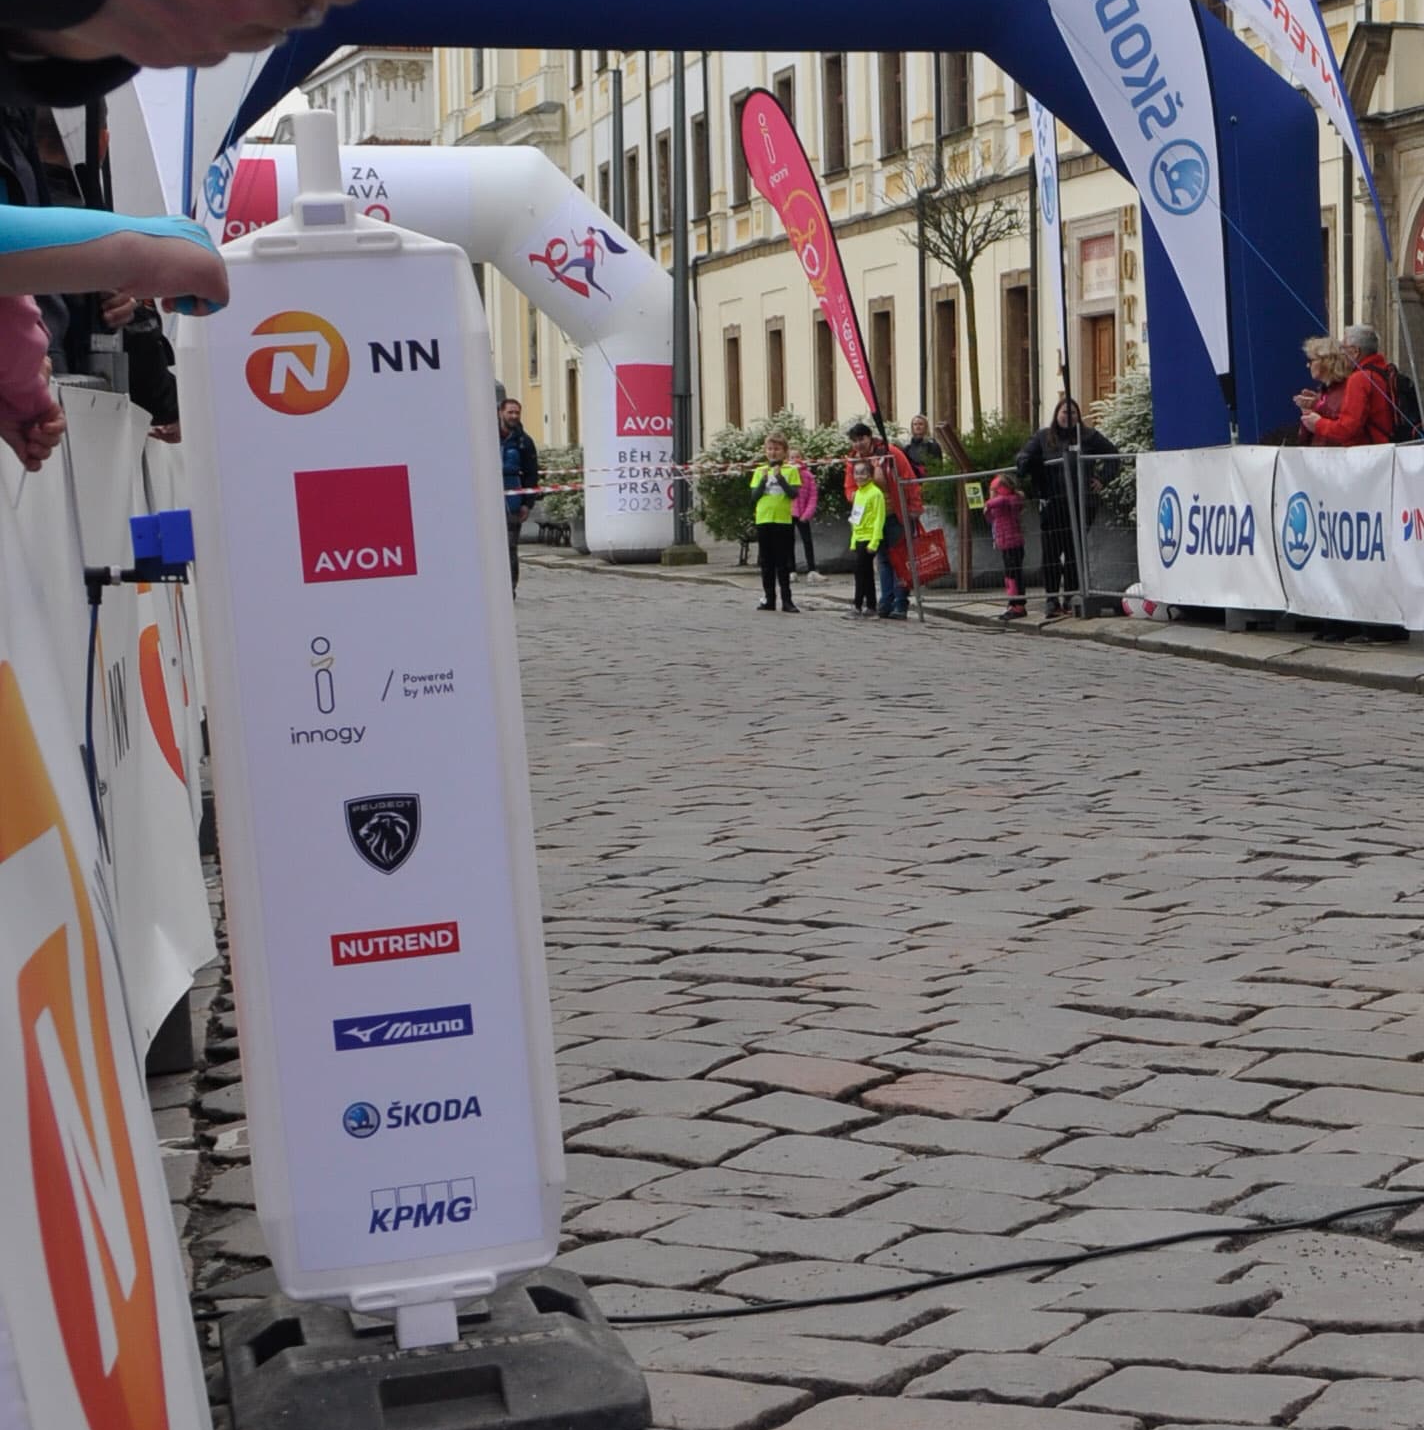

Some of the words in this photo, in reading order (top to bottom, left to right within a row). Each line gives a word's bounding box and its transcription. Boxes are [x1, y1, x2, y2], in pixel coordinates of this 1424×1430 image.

[352, 167, 379, 179] ZA
[368, 339, 441, 373] NN
[618, 497, 663, 511] 2023
[1186, 494, 1255, 556] ŠKODA
[1318, 501, 1386, 561] ŠKODA
[314, 546, 403, 573] AVON
[402, 670, 453, 684] Powered
[403, 686, 418, 699] by
[423, 683, 454, 695] MVM
[290, 726, 366, 745] innogy
[351, 800, 412, 812] PEUGEOT
[338, 929, 454, 959] NUTREND
[386, 1096, 482, 1128] ŠKODA
[368, 1196, 473, 1234] KPMG
